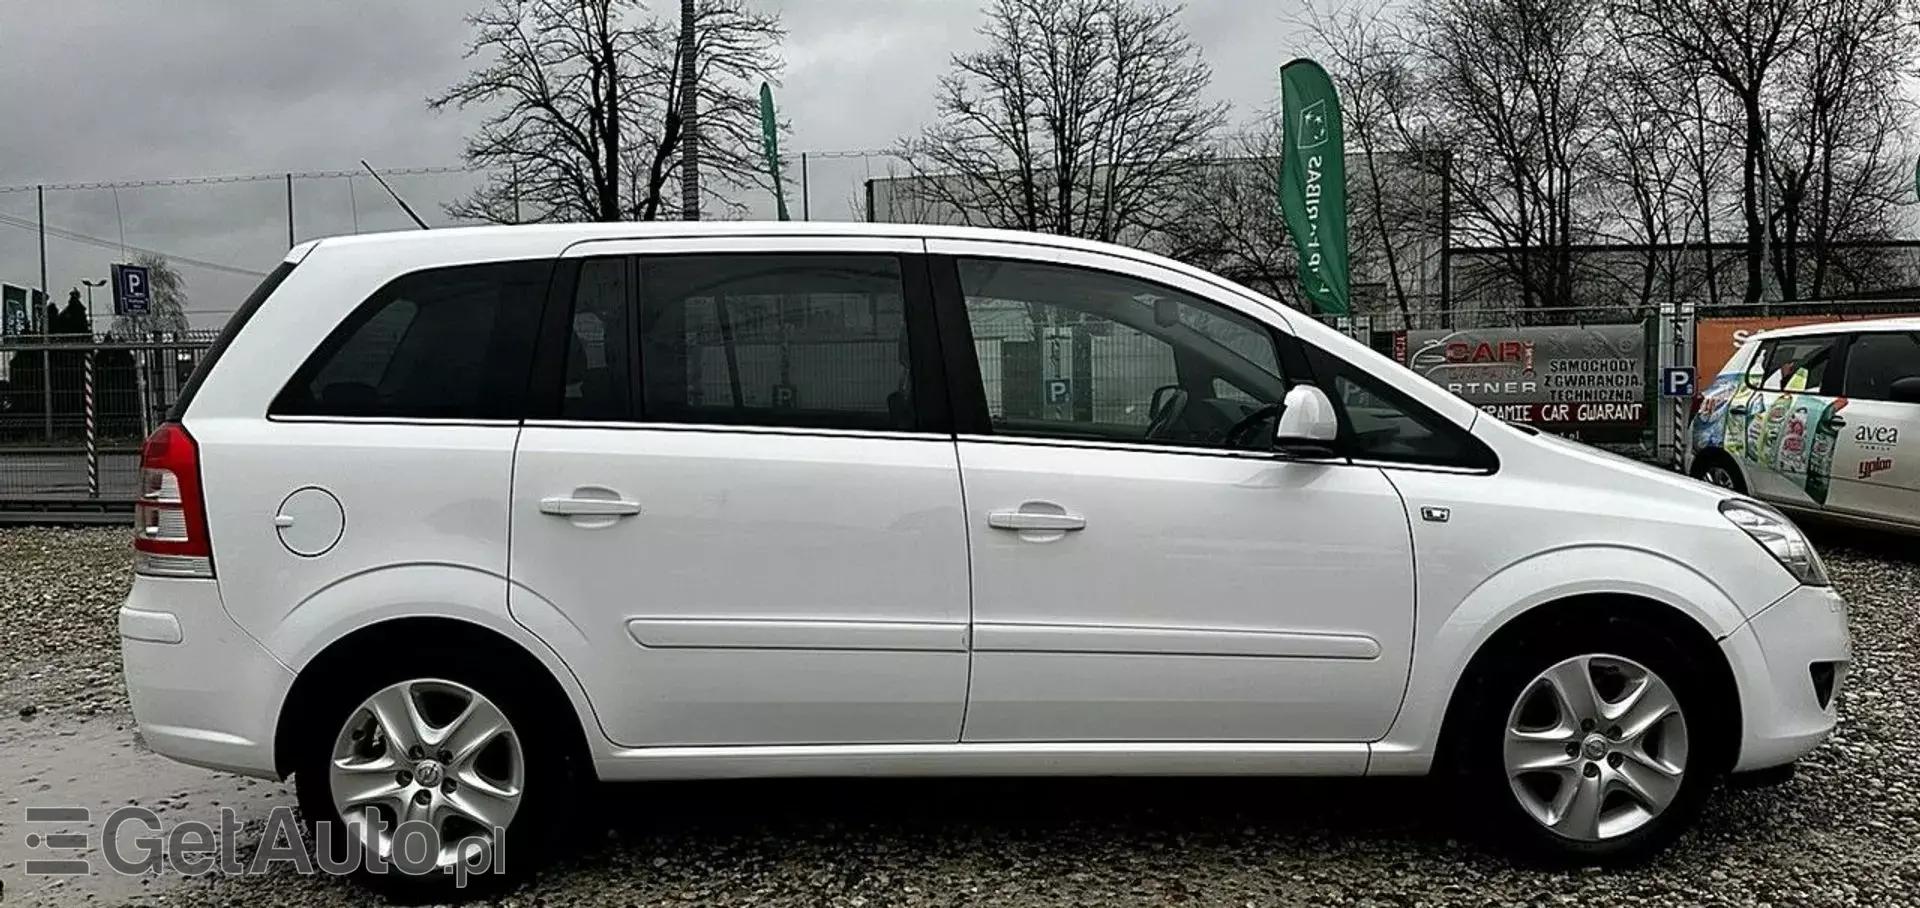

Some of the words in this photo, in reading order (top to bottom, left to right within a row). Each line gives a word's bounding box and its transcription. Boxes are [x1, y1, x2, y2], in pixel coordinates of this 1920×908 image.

[1446, 341, 1521, 363] CAR
[1550, 359, 1637, 373] SAMOCHODY
[1670, 371, 1689, 393] P
[1541, 404, 1569, 421] CAR
[1855, 426, 1898, 443] avea
